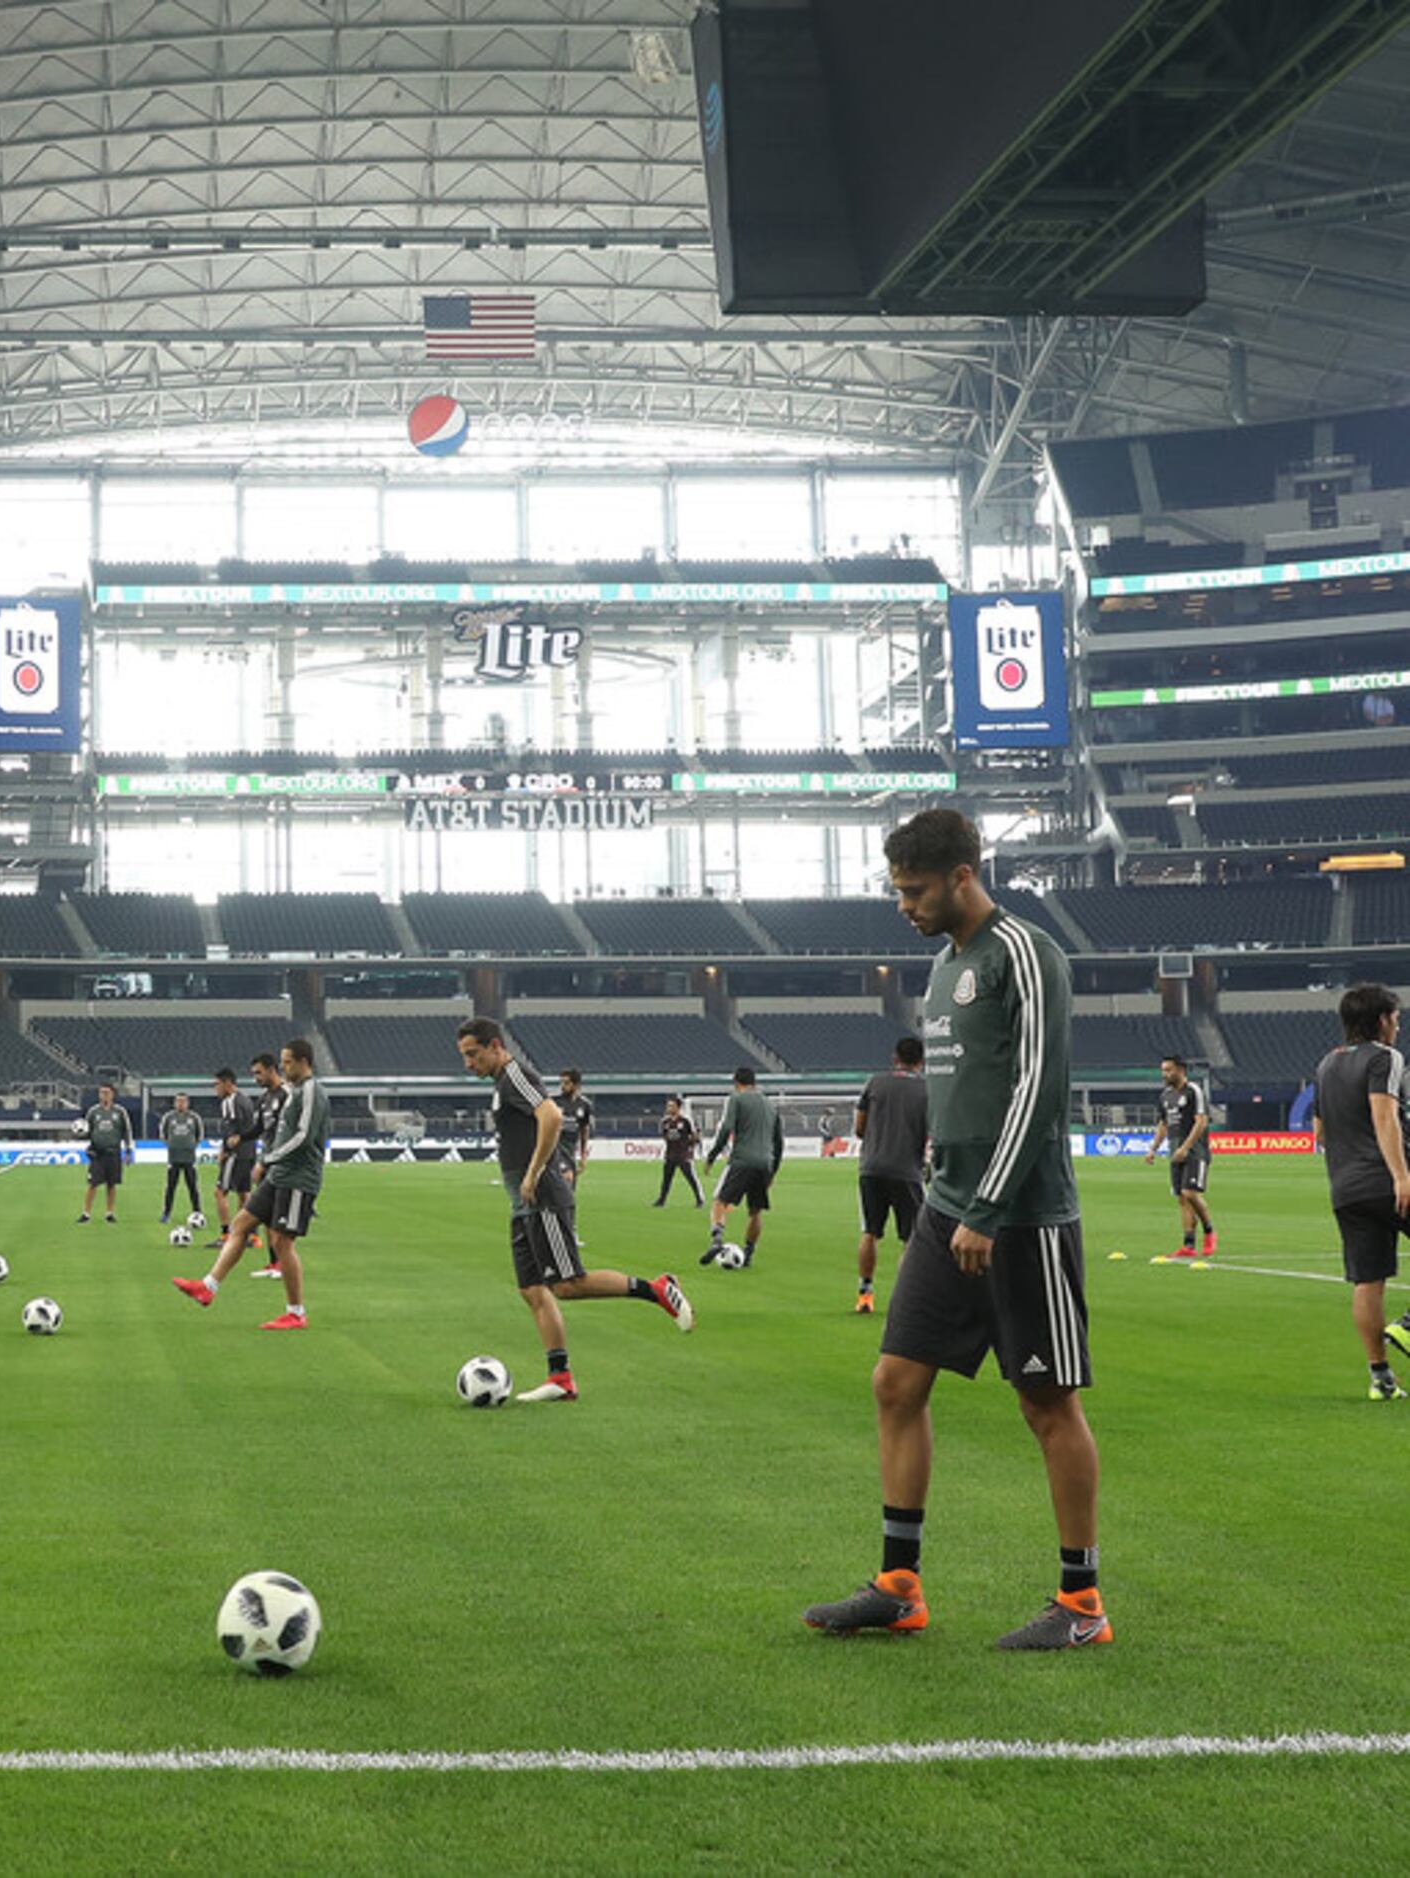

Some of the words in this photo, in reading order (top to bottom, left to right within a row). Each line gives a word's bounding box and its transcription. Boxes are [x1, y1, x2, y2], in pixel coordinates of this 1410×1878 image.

[5, 628, 53, 658] Lite
[476, 623, 582, 680] Lite
[986, 626, 1035, 656] Lite
[408, 801, 491, 829] AT&T
[501, 800, 654, 829] STADIUM
[1260, 1133, 1311, 1149] FARGO
